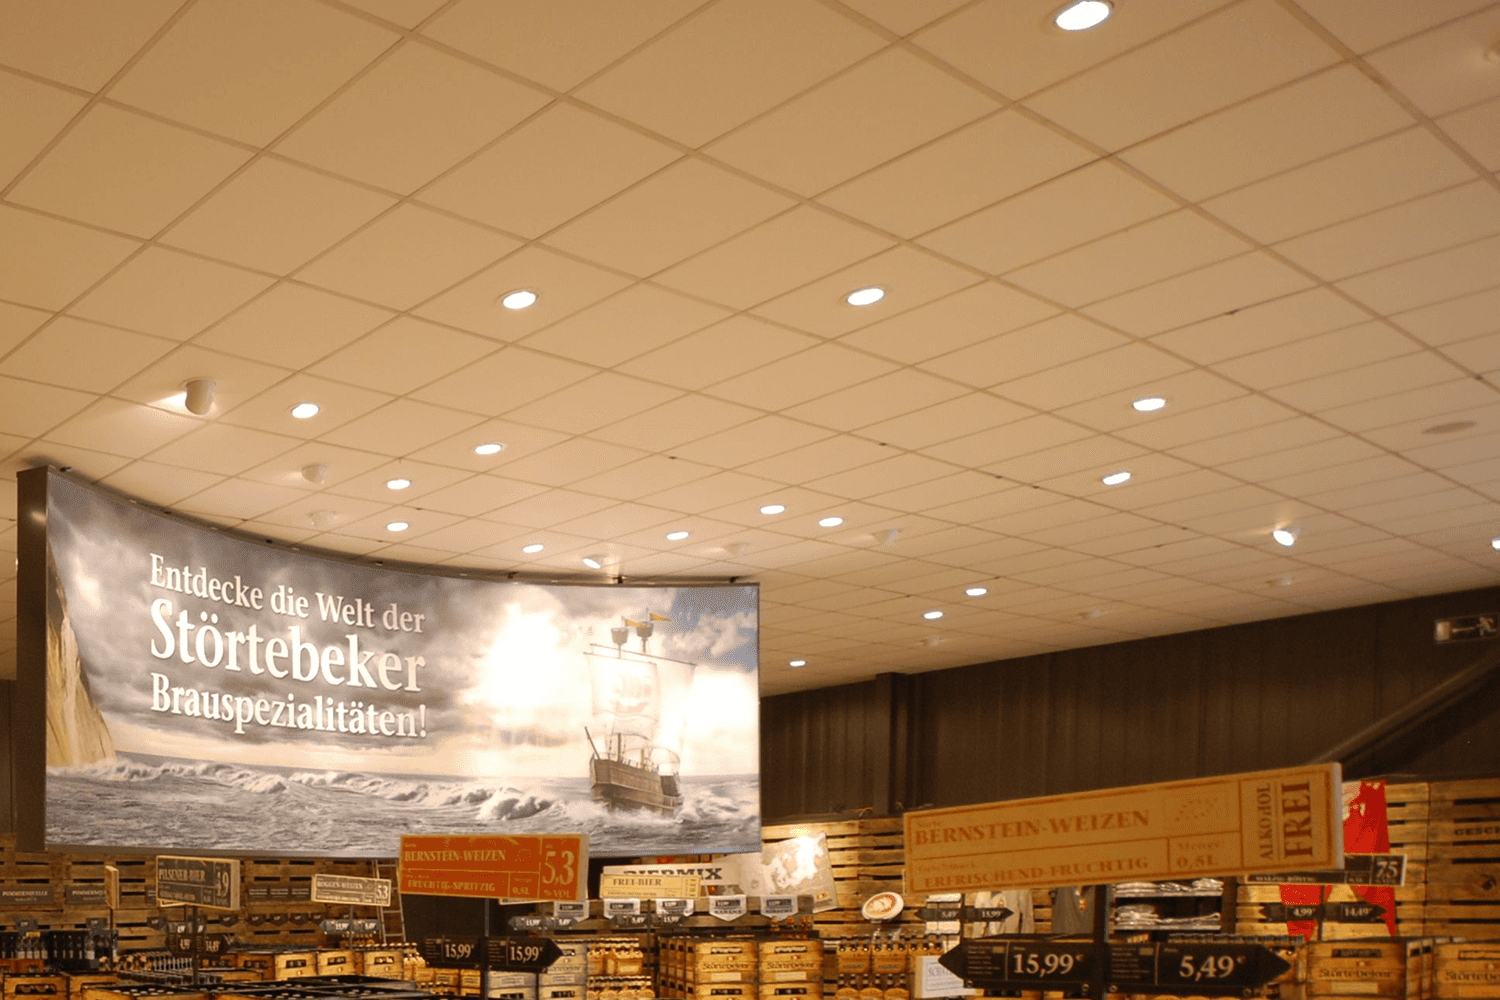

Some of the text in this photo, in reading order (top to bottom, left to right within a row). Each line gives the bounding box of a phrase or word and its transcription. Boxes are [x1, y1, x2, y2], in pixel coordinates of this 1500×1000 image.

[150, 553, 425, 633] Entdecke die Welt der
[150, 598, 426, 693] Störtebeker
[150, 673, 428, 738] Brauspezialitäten!
[915, 810, 1149, 845] BERNSTEIN-WEIZEN
[1257, 783, 1274, 861] ALKOHOL
[1282, 781, 1313, 859] FREI
[404, 850, 506, 861] BERNSTEIN-WEIZEN
[542, 850, 575, 886] 5,3
[925, 857, 1148, 888] ERFRISCHEND-FRUCHTIG
[445, 944, 472, 959] 15,99
[510, 946, 539, 961] 15,99
[1013, 953, 1074, 978] 15,99
[1179, 955, 1235, 982] 5,49
